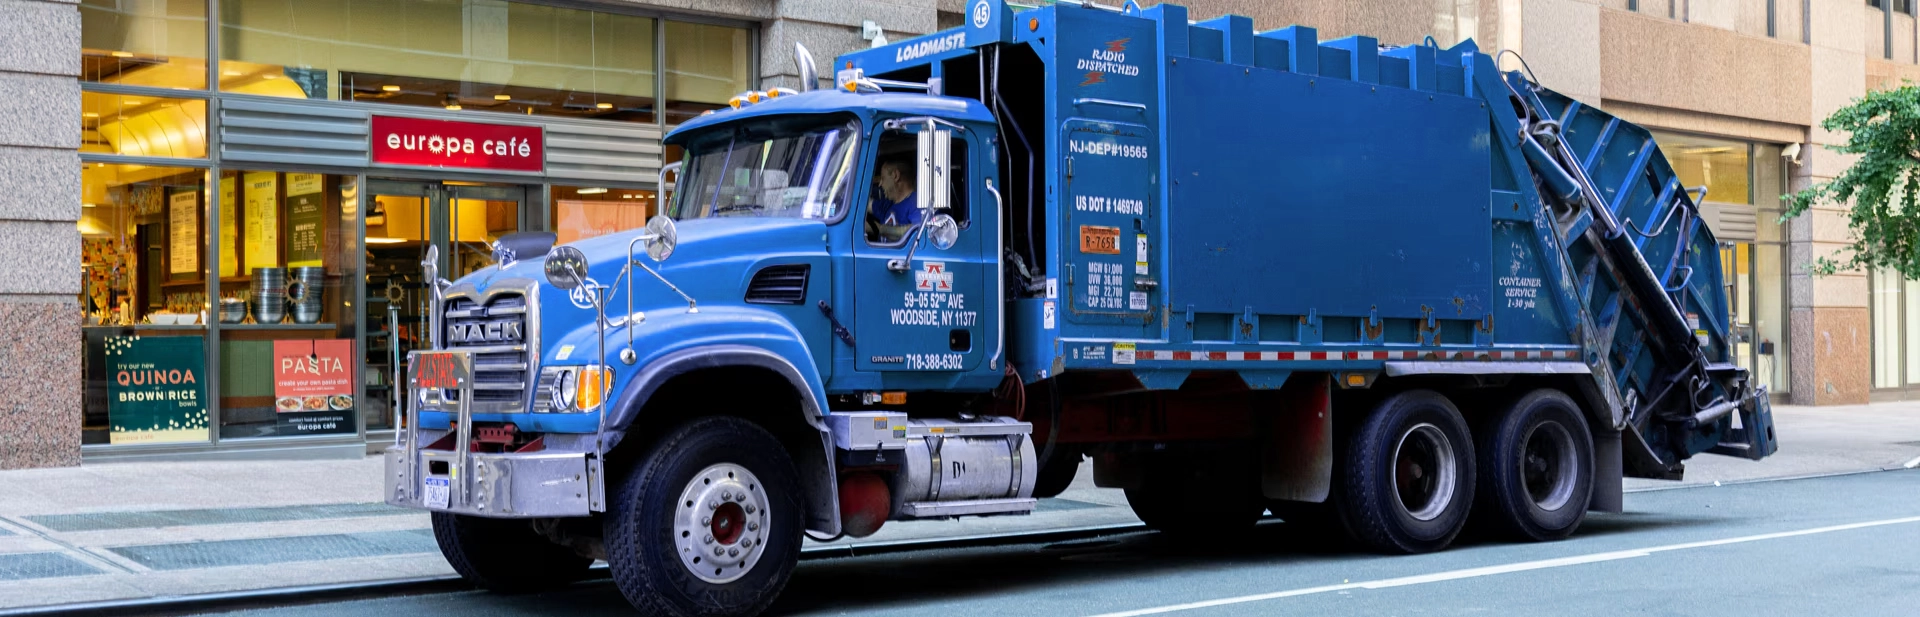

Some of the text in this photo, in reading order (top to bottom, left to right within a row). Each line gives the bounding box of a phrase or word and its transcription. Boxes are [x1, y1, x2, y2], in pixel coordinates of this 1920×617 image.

[975, 6, 987, 23] 45
[1092, 49, 1125, 63] RADIO
[1077, 58, 1139, 76] DISPATCHED
[387, 133, 531, 157] europa café
[1069, 139, 1148, 159] NJ-DEP#19565
[1075, 195, 1143, 215] US DOT # 1469749
[1085, 235, 1115, 249] R-7658
[1088, 261, 1103, 274] MGW
[1088, 273, 1101, 285] UVW
[1498, 276, 1542, 288] CONTAINER
[573, 284, 596, 303] 45
[1088, 285, 1100, 297] MGI
[1104, 286, 1123, 298] 22,700
[1505, 287, 1537, 298] SERVICE
[904, 292, 928, 308] 59-05
[948, 294, 964, 309] AVE
[1087, 297, 1099, 308] CAP
[1507, 298, 1535, 310] 1-30 yds
[891, 309, 977, 328] WOODSIDE, NY 11377
[449, 322, 521, 342] MACK
[282, 355, 344, 375] PASTA
[906, 353, 963, 369] 718-388-6302
[117, 369, 196, 386] QUINOA
[415, 352, 457, 388] ALLSTATE
[322, 379, 336, 387] pasta
[119, 390, 196, 402] BROWN RICE
[298, 422, 337, 431] europa café
